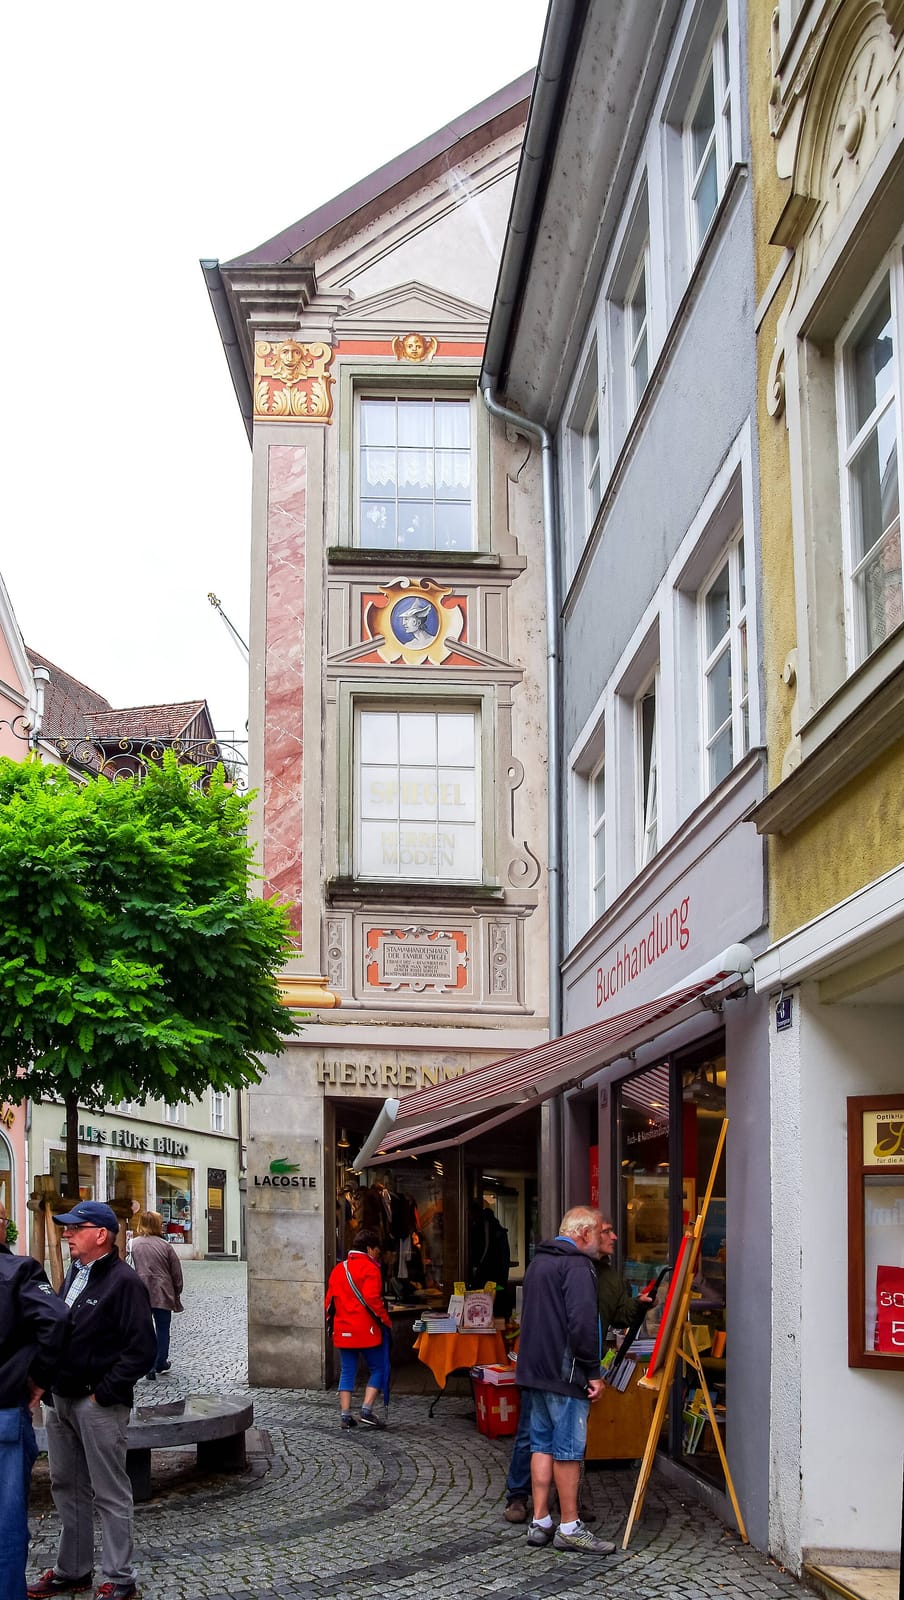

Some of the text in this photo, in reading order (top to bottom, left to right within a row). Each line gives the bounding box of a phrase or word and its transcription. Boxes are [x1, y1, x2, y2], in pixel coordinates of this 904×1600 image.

[369, 781, 466, 806] SPIEGEL
[381, 832, 456, 849] HERREN
[382, 848, 454, 866] MODEN
[596, 896, 690, 1008] Buchhandlung
[111, 1130, 150, 1151] FÜRS
[153, 1136, 190, 1158] BÜRO
[254, 1175, 316, 1188] LACOSTE
